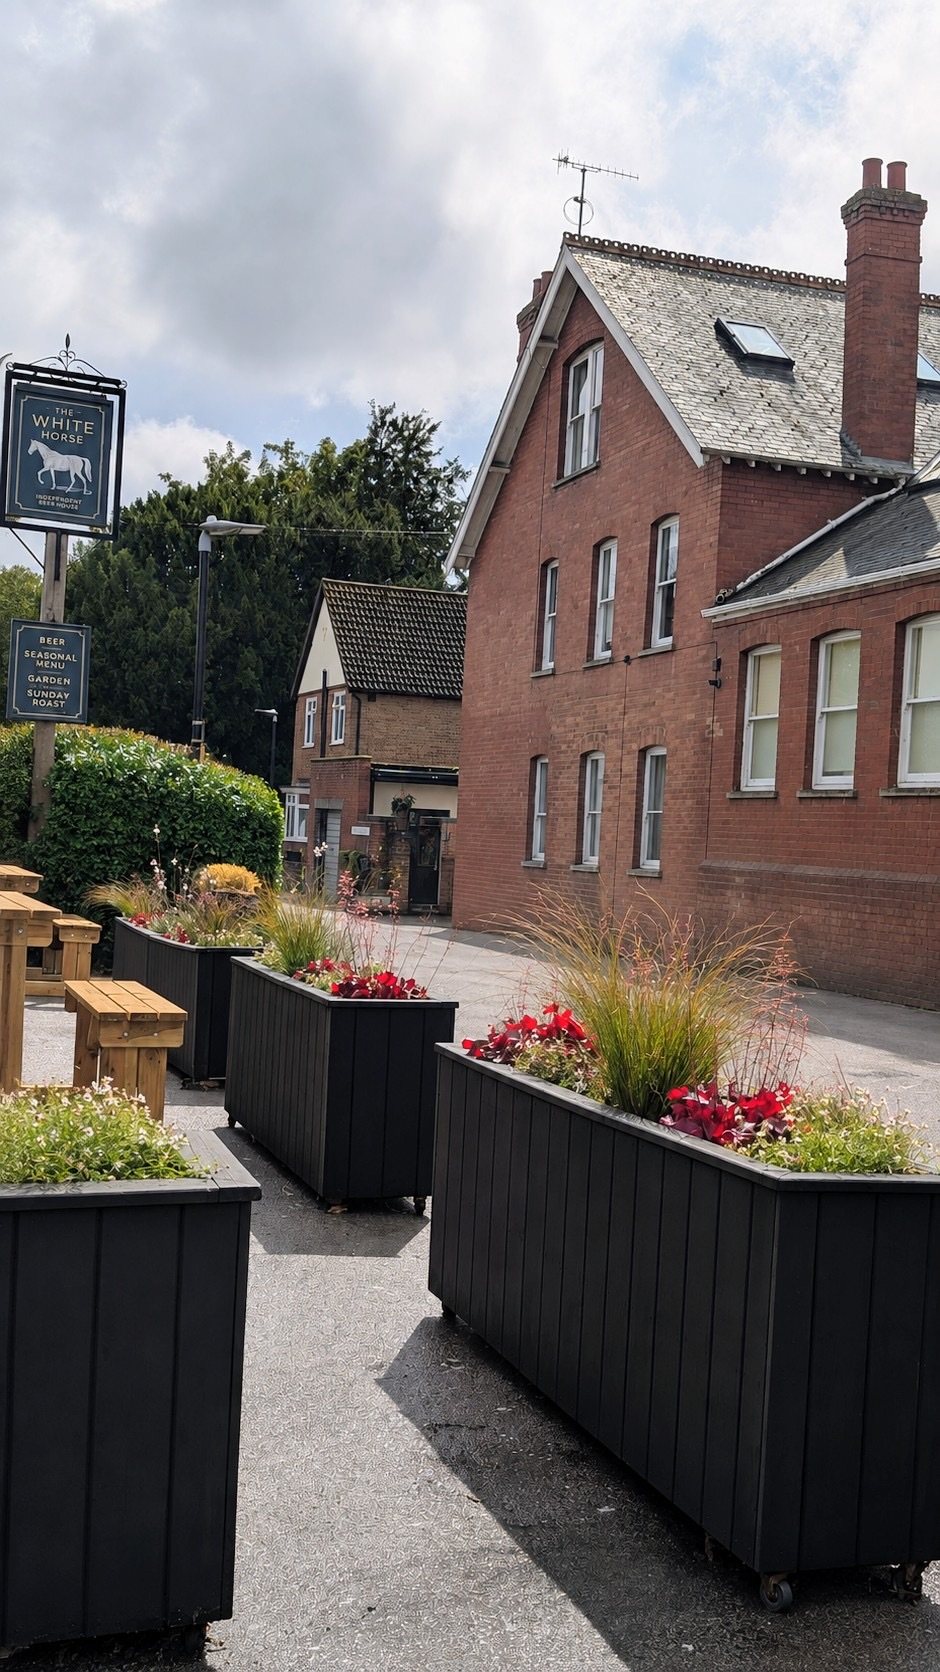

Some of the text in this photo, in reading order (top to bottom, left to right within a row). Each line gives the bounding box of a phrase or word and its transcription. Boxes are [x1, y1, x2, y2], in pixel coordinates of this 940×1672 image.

[55, 407, 74, 417] THE
[32, 414, 95, 435] WHITE
[41, 431, 84, 444] HORSE
[39, 636, 65, 646] BEER
[24, 650, 78, 662] SEASONAL
[36, 660, 65, 670] MENU
[27, 674, 71, 685] GARDEN
[27, 689, 70, 700] SUNDAY
[32, 698, 66, 708] ROAST
